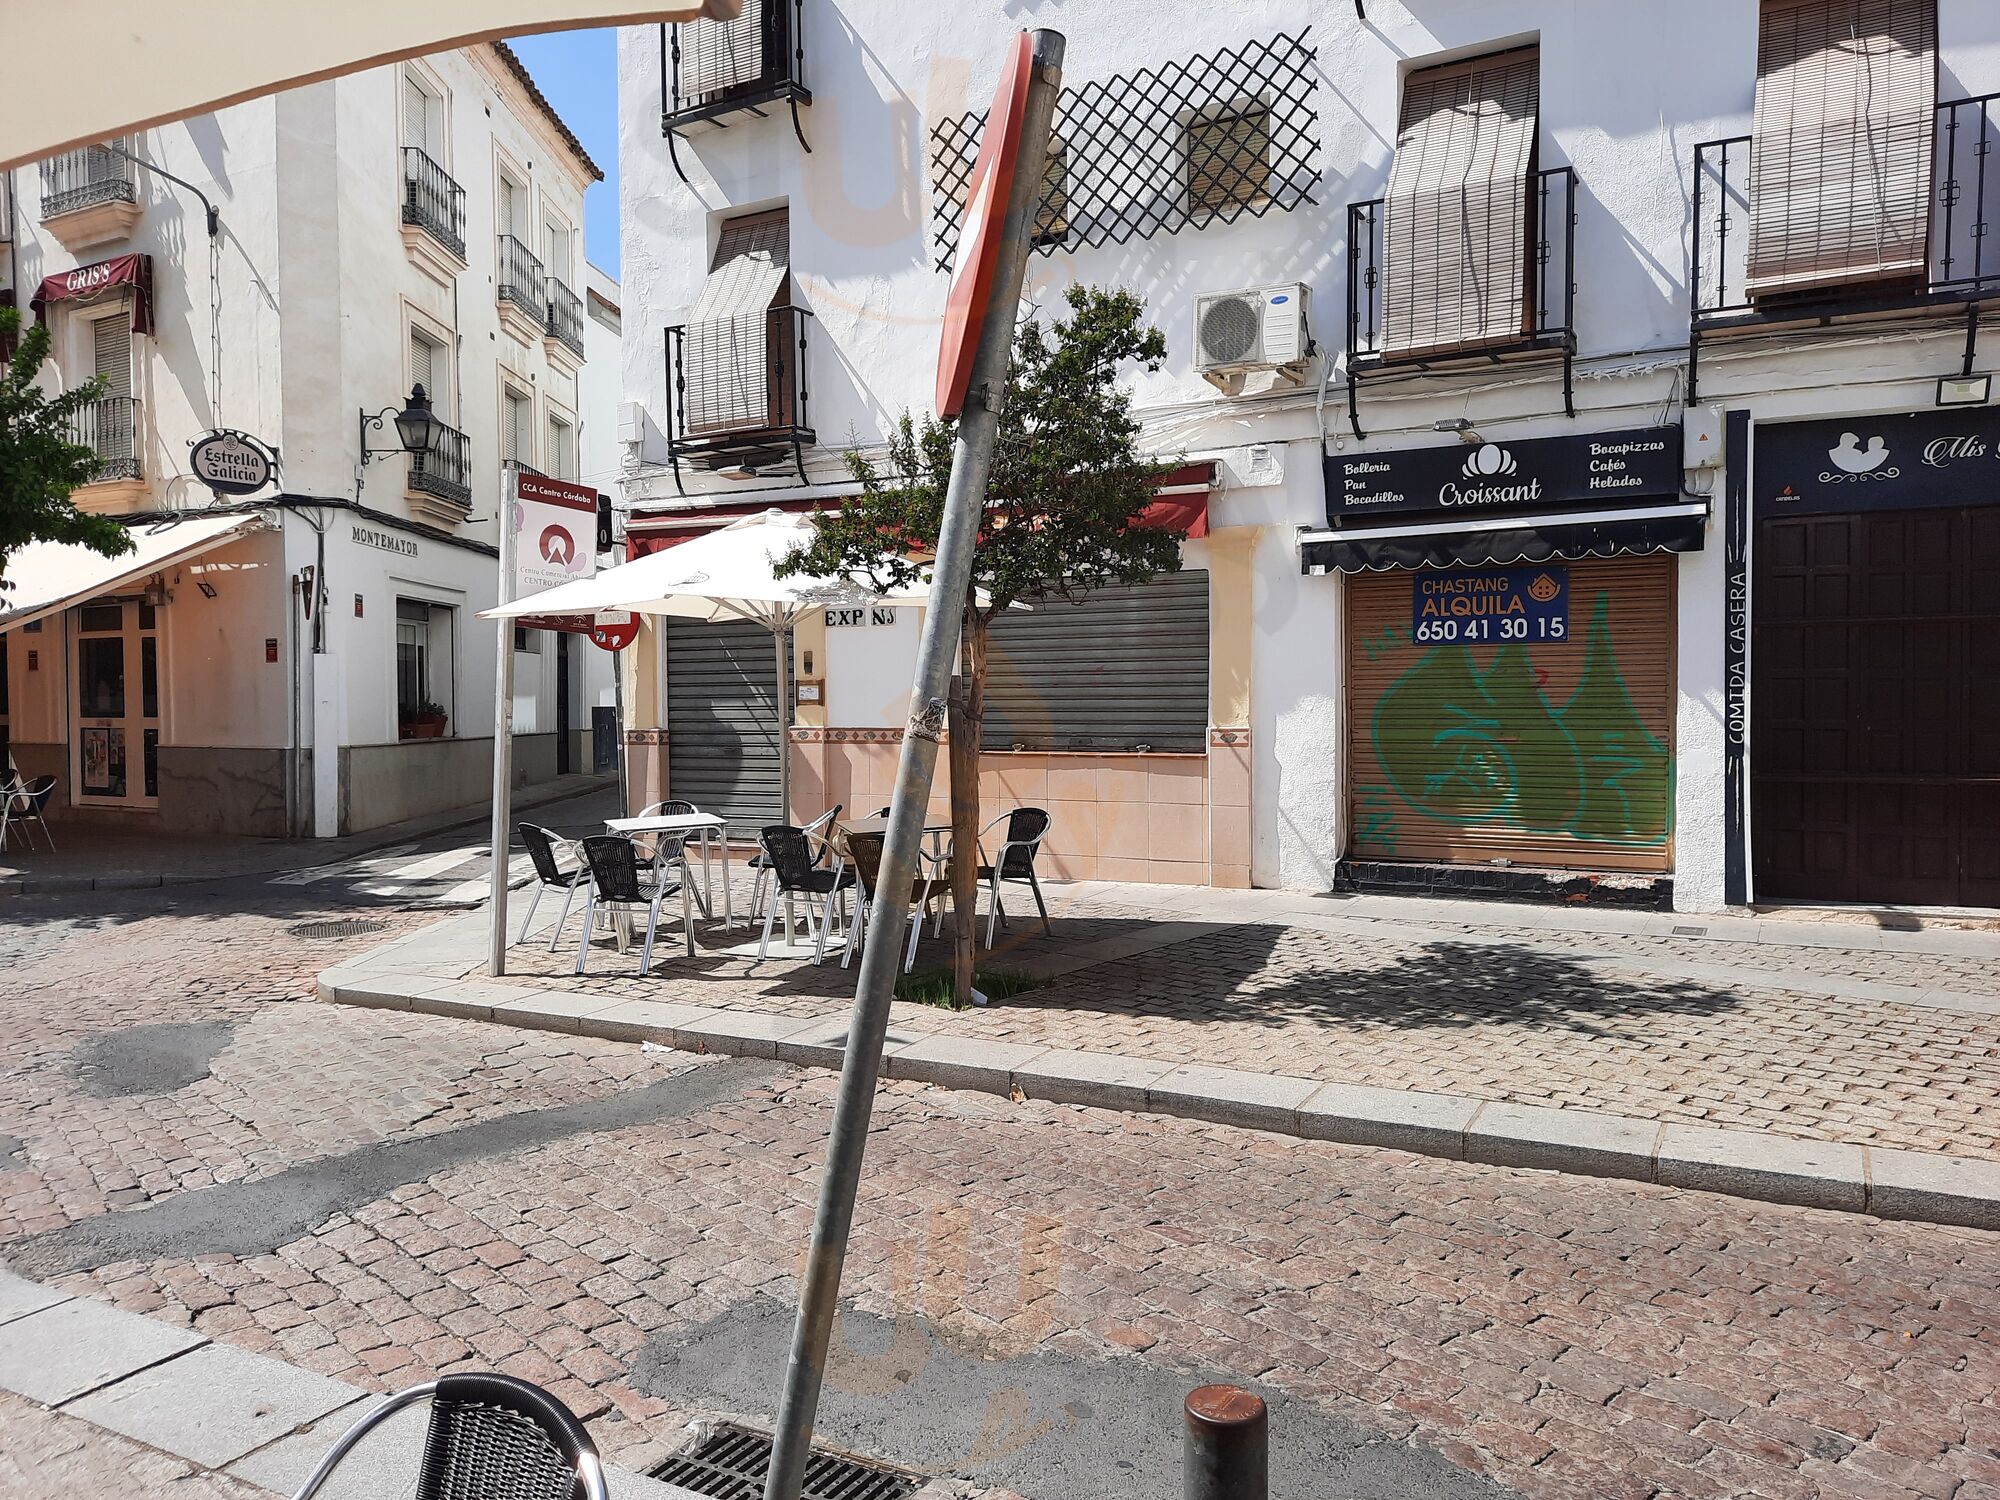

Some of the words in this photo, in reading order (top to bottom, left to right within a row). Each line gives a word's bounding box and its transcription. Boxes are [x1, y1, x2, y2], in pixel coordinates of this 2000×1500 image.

[66, 263, 111, 291] GRIS'S
[204, 447, 259, 468] Estrella
[1589, 441, 1665, 455] Bocapizzas
[1920, 434, 1987, 468] Mis
[207, 462, 257, 482] Galicia
[1589, 458, 1626, 472] Cafés
[1343, 478, 1367, 491] Pan
[1438, 477, 1542, 506] Croissant
[1589, 474, 1643, 489] Helados
[522, 482, 538, 493] CCA
[539, 486, 562, 498] Centro
[563, 490, 591, 504] Córdoba
[1343, 491, 1405, 506] Bocadillos
[352, 526, 418, 556] MONTEMAYOR
[520, 566, 539, 575] Centro
[524, 576, 552, 587] CENTRO
[1422, 577, 1509, 595] CHASTANG
[1421, 594, 1526, 617] ALQUILA
[1729, 572, 1746, 654] CASERA
[1416, 619, 1458, 641] 650
[1463, 619, 1489, 639] 41
[1499, 617, 1528, 638] 30
[1537, 616, 1565, 638] 15
[1728, 660, 1745, 744] COMIDA
